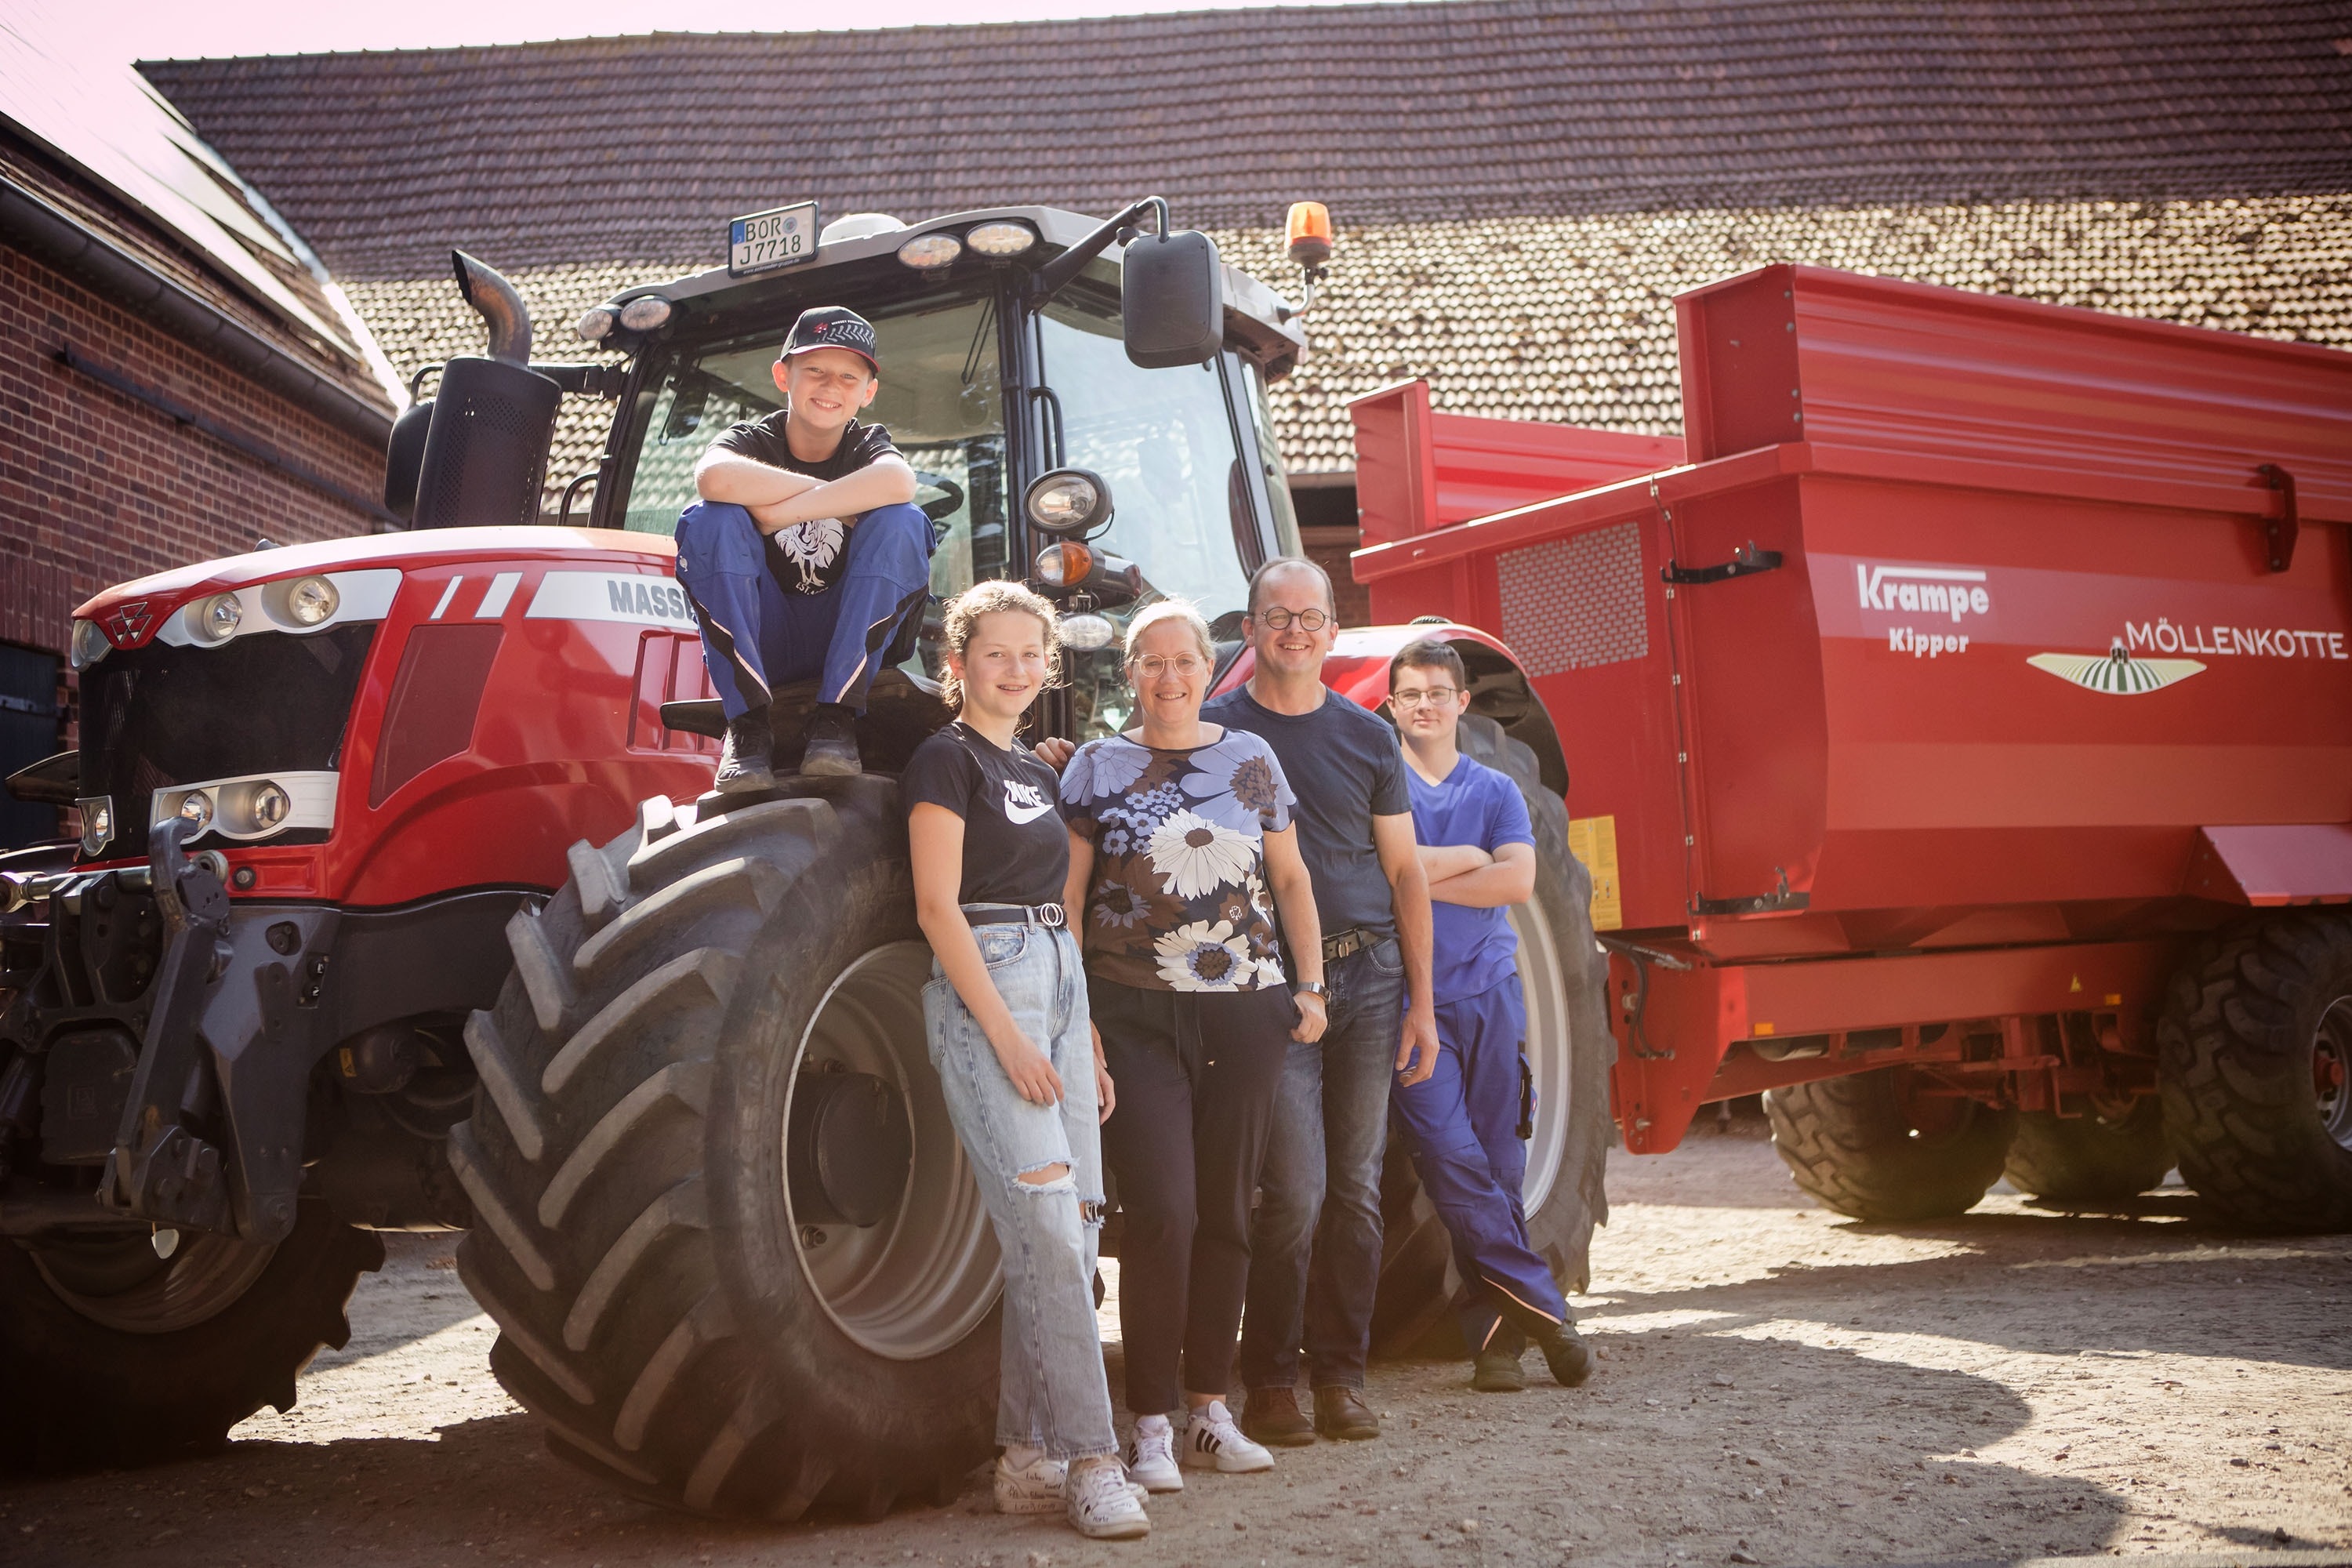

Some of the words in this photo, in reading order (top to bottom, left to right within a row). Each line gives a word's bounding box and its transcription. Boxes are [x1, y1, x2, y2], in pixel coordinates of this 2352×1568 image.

[746, 216, 781, 242] BOR
[740, 234, 801, 265] J7718
[1857, 563, 1990, 623] Krampe
[1889, 626, 1969, 659] Kipper
[2125, 617, 2350, 659] MÖLLENKOTTE
[1004, 779, 1045, 807] NIKE
